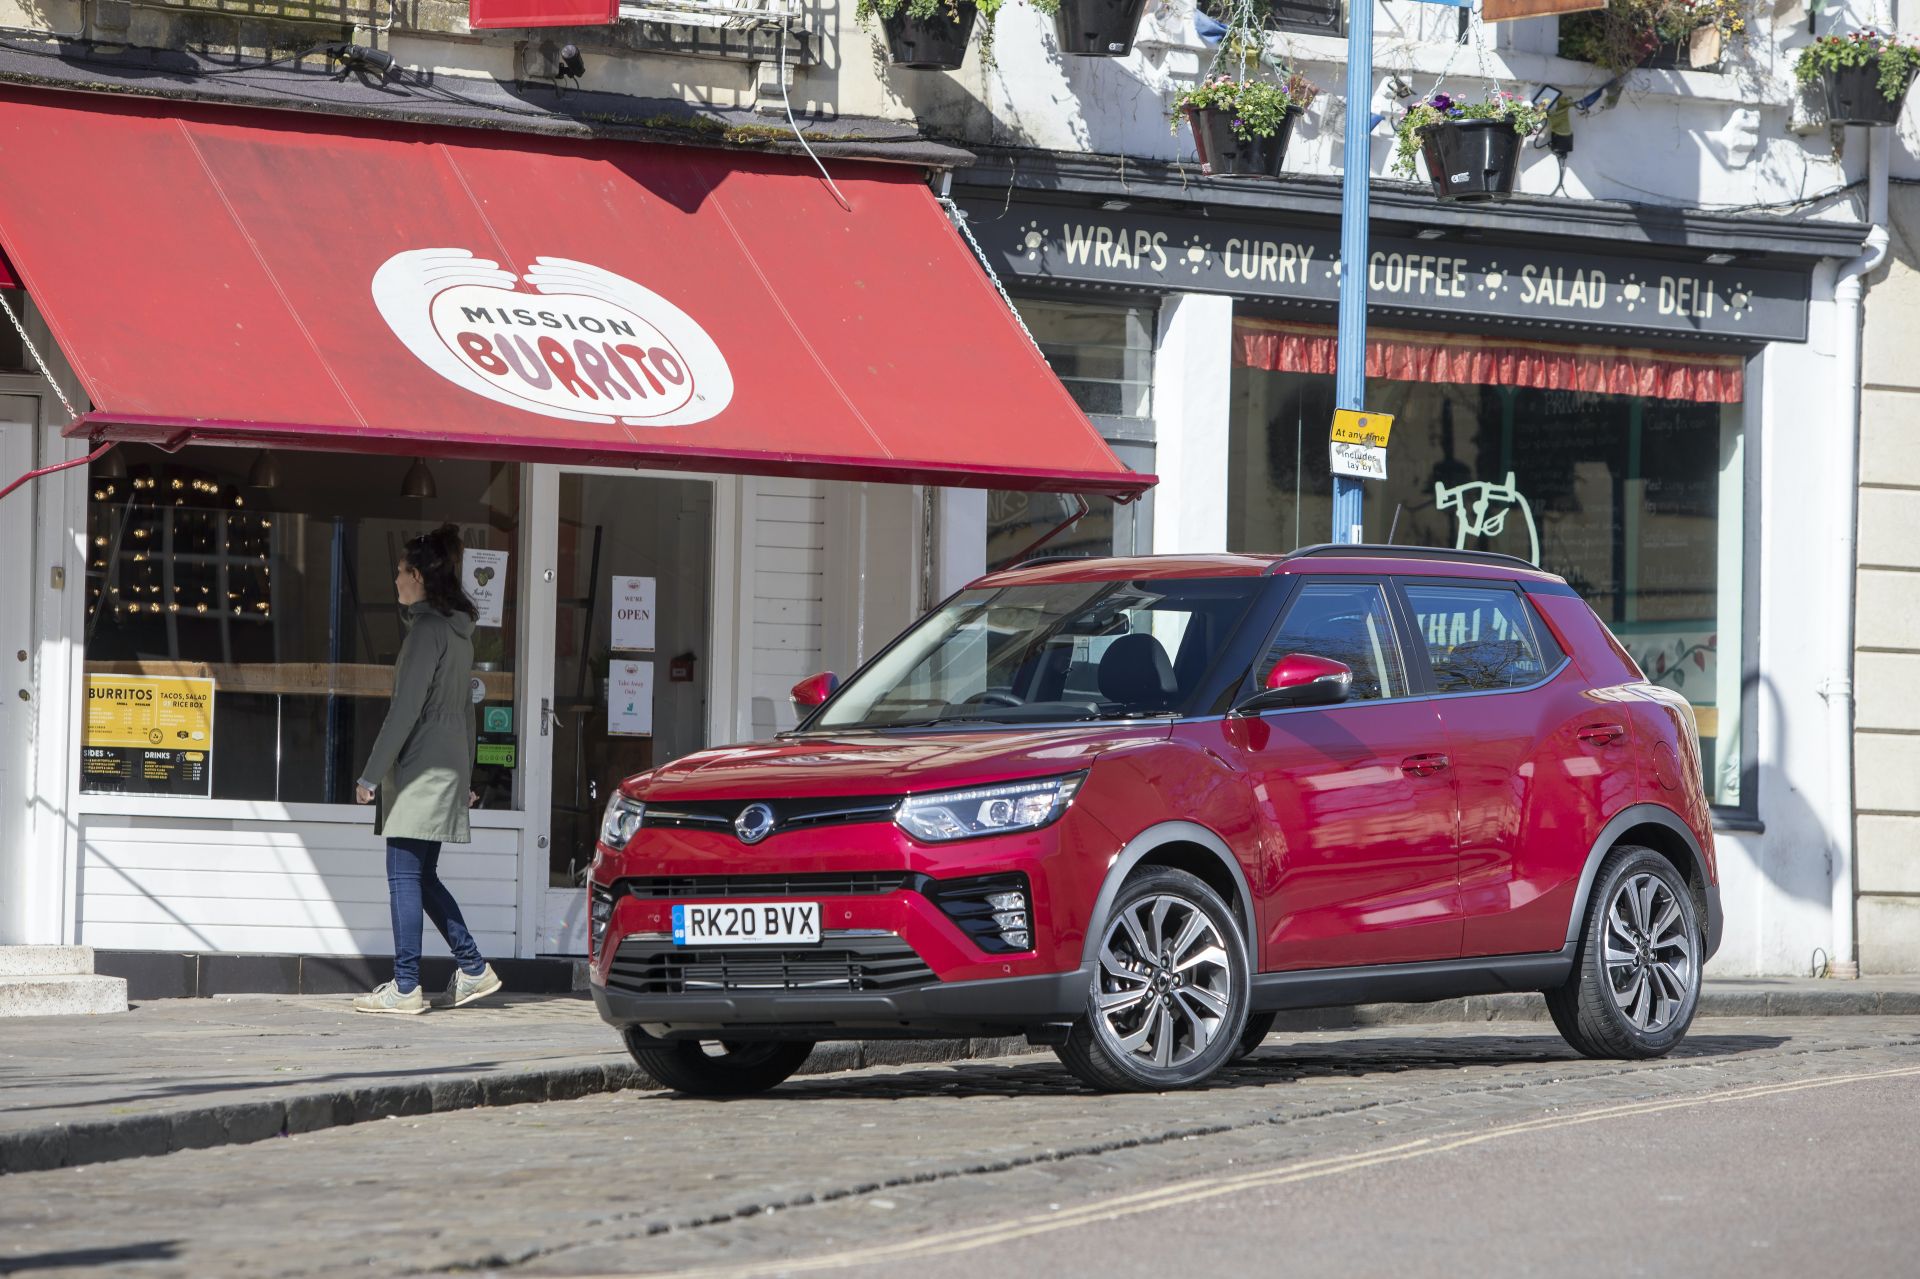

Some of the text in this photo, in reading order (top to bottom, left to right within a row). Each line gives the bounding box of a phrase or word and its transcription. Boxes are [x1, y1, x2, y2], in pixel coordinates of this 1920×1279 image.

[1064, 223, 1714, 319] WRAPS CURRY COFFEE SALAD DELI
[460, 306, 636, 337] MISSION
[456, 331, 685, 401] BURRITO
[1335, 428, 1346, 437] At
[1348, 431, 1363, 440] any
[1341, 451, 1377, 462] includes
[1347, 461, 1372, 472] lay by
[617, 608, 650, 620] OPEN
[88, 687, 153, 700] BURRITOS
[160, 692, 207, 701] TACOS, SALAD
[189, 701, 204, 709] BOX
[83, 749, 104, 758] SIDES
[144, 751, 170, 759] DRINKS
[691, 906, 814, 937] RK20 BVX
